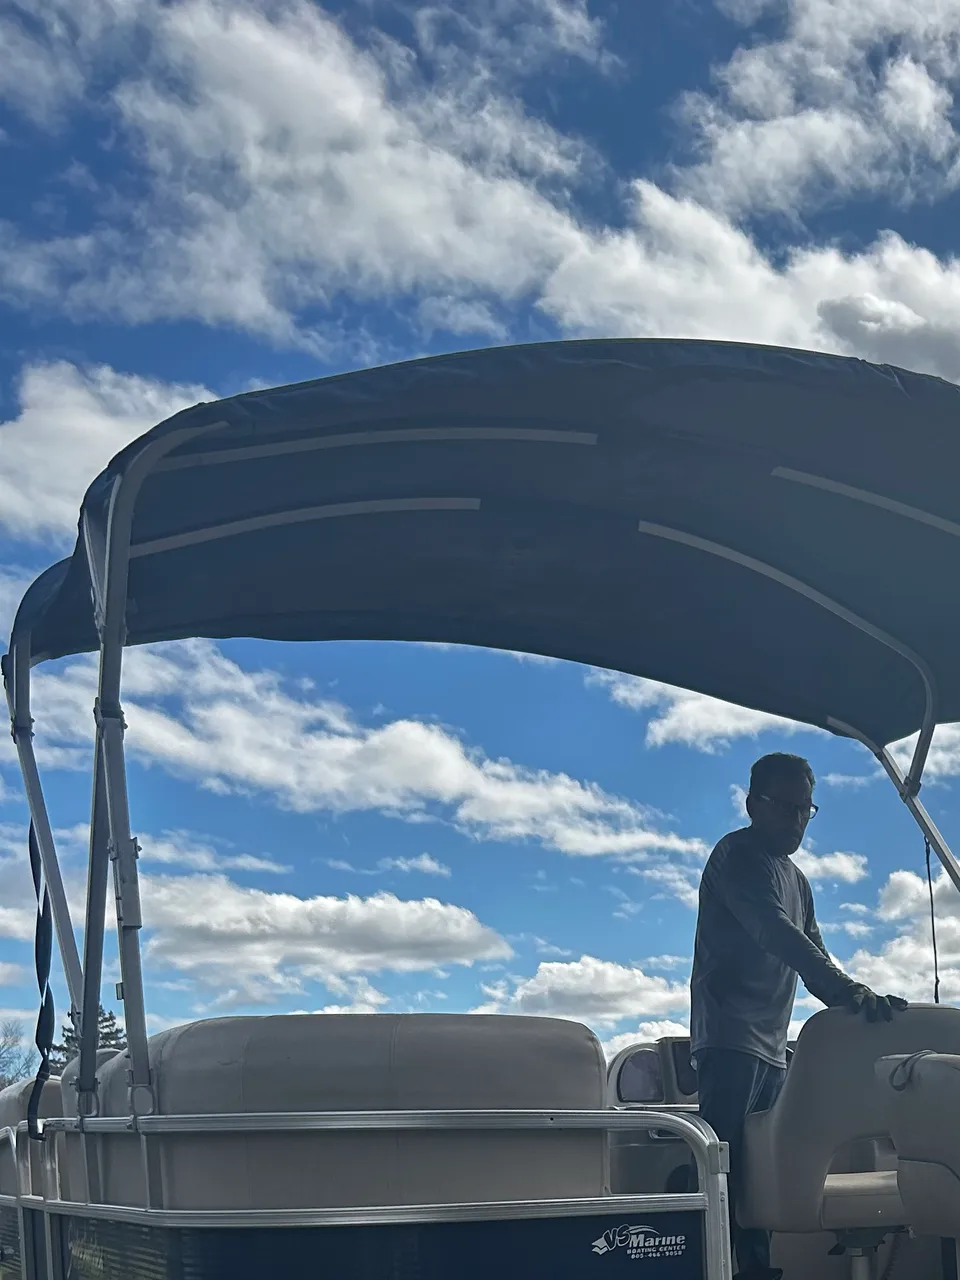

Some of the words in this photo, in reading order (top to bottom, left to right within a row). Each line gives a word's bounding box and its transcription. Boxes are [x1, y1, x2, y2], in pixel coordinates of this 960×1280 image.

[603, 1224, 631, 1251] VS
[628, 1233, 686, 1248] Marine
[626, 1247, 657, 1255] BOATING
[659, 1244, 687, 1252] CENTER
